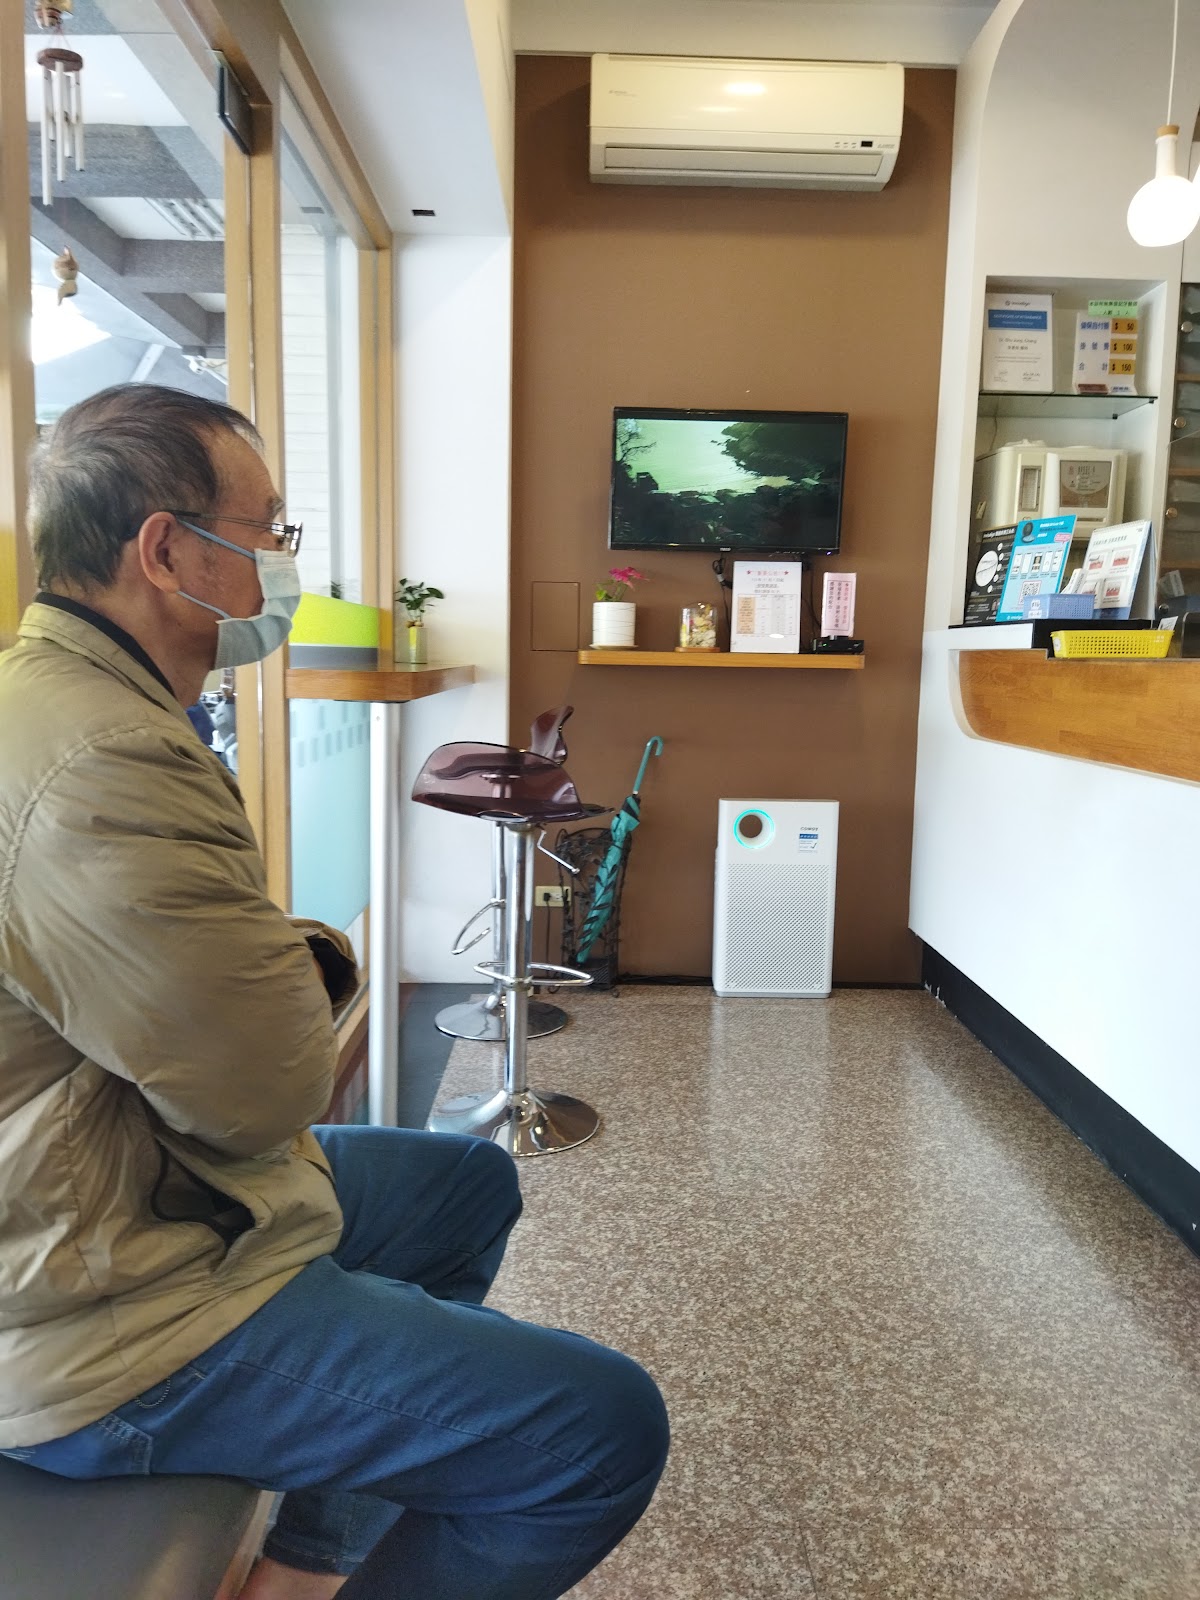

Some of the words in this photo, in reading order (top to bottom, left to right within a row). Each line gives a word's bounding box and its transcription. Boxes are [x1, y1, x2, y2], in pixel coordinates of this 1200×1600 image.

[1127, 323, 1134, 331] 50
[1122, 343, 1133, 351] 100
[1121, 363, 1132, 372] 150
